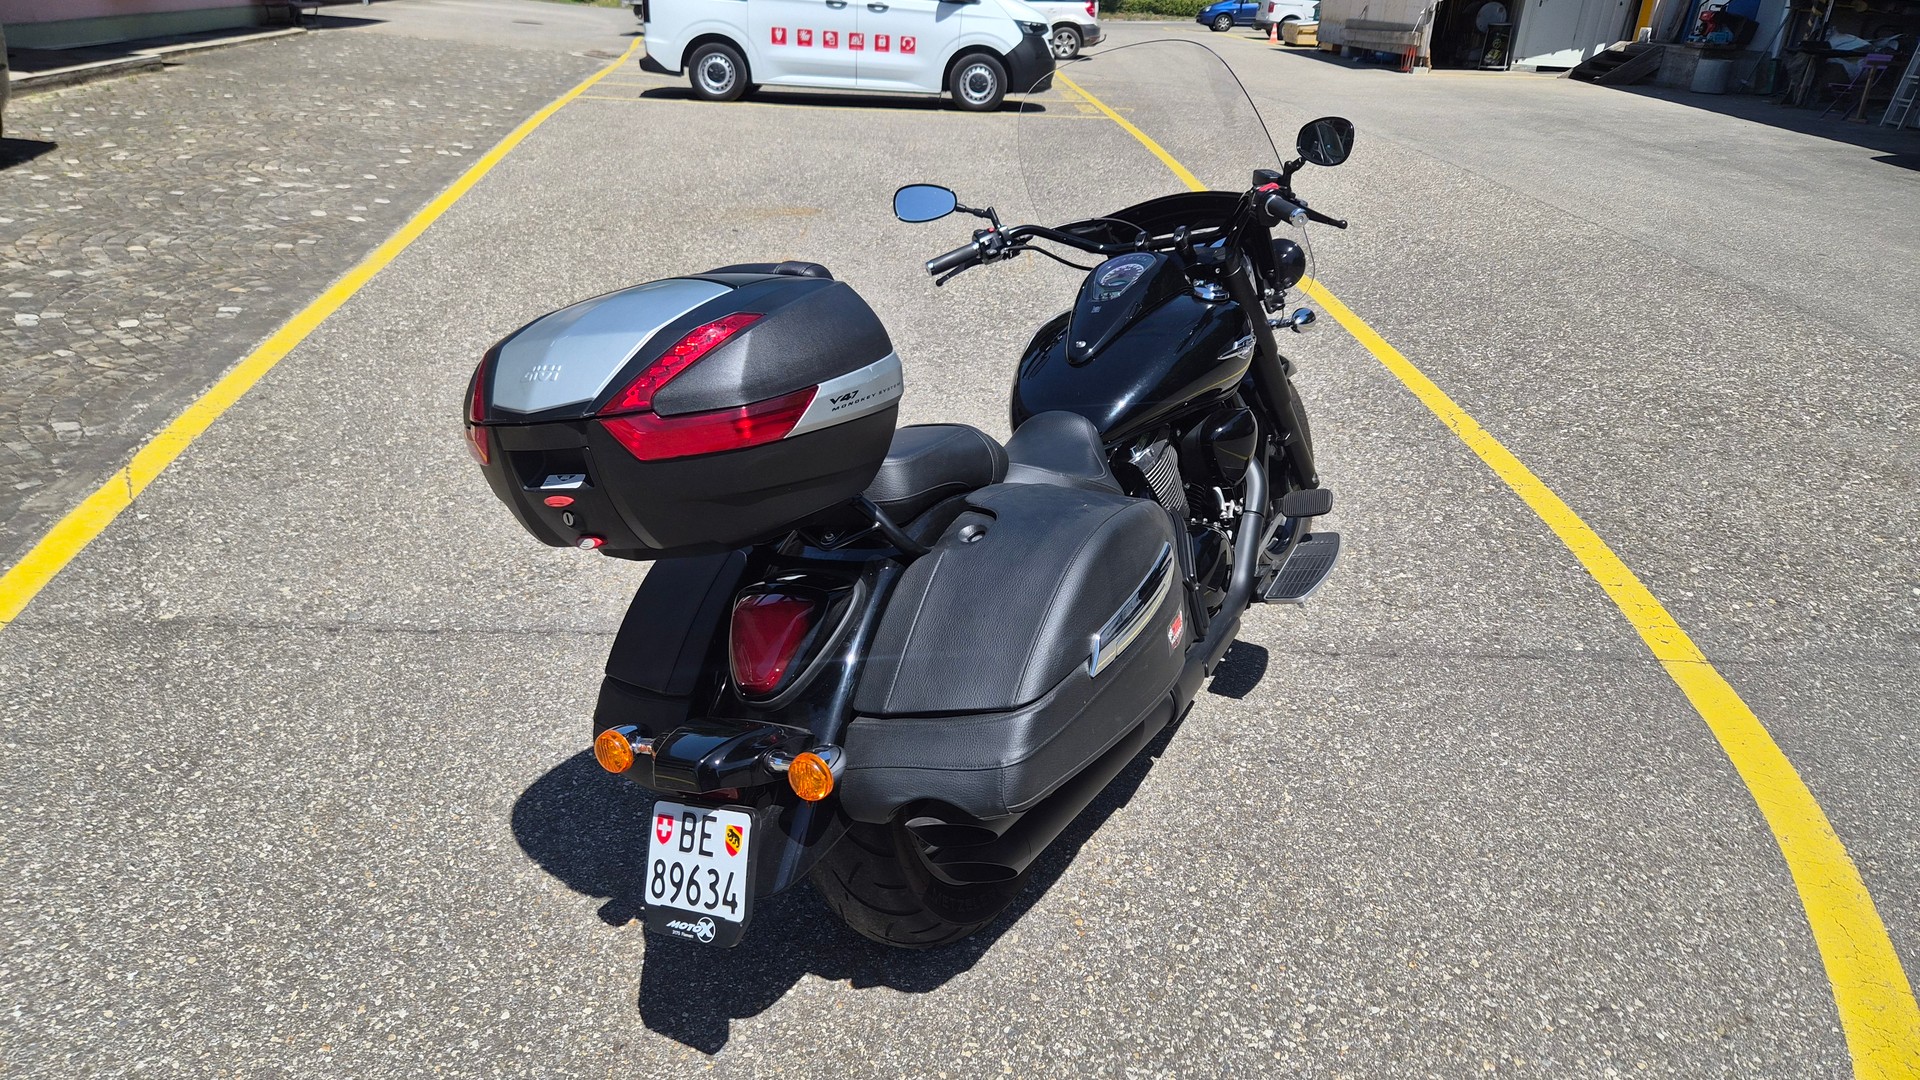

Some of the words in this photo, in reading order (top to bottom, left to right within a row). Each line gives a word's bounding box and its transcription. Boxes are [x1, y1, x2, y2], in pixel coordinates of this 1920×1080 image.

[829, 389, 860, 405] V47
[679, 811, 717, 858] BE
[651, 858, 738, 914] 89634
